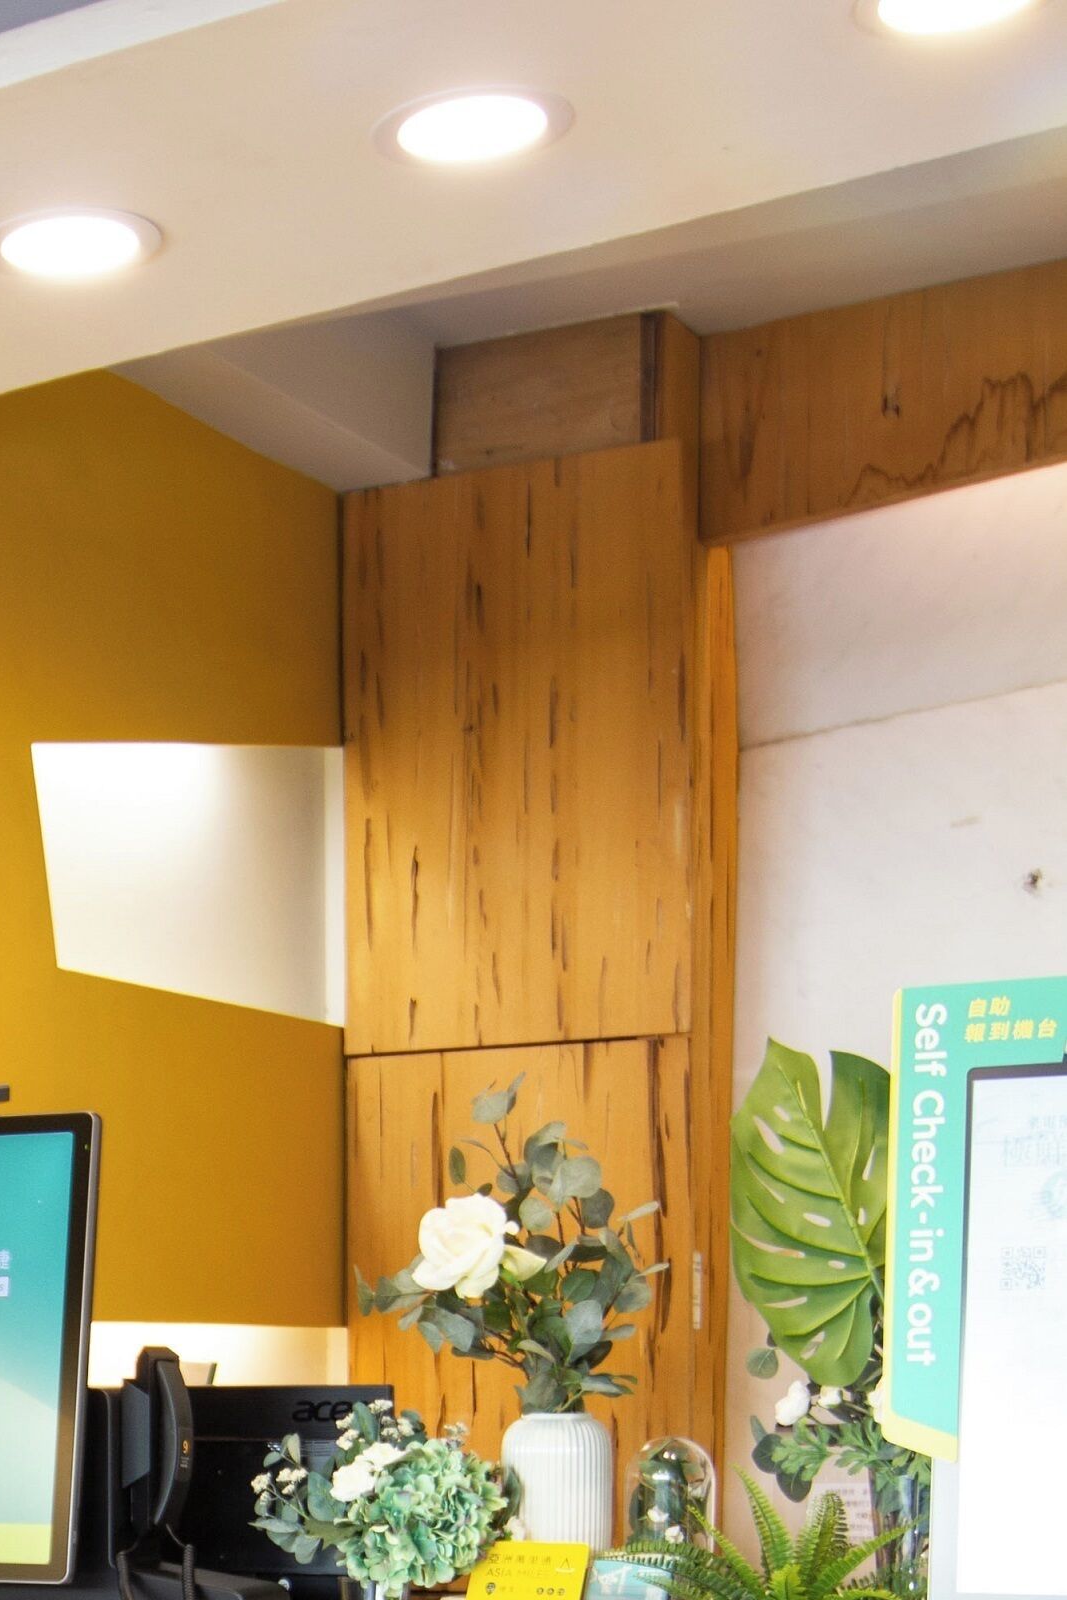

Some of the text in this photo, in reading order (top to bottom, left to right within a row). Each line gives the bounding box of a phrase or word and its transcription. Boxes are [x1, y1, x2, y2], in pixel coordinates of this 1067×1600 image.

[968, 995, 1011, 1018] 自助
[914, 1003, 948, 1077] Self
[964, 1018, 1057, 1043] 報到機台
[909, 1090, 945, 1262] Check-in
[906, 1302, 936, 1366] out
[293, 1400, 368, 1421] ace
[486, 1568, 512, 1578] ASIA
